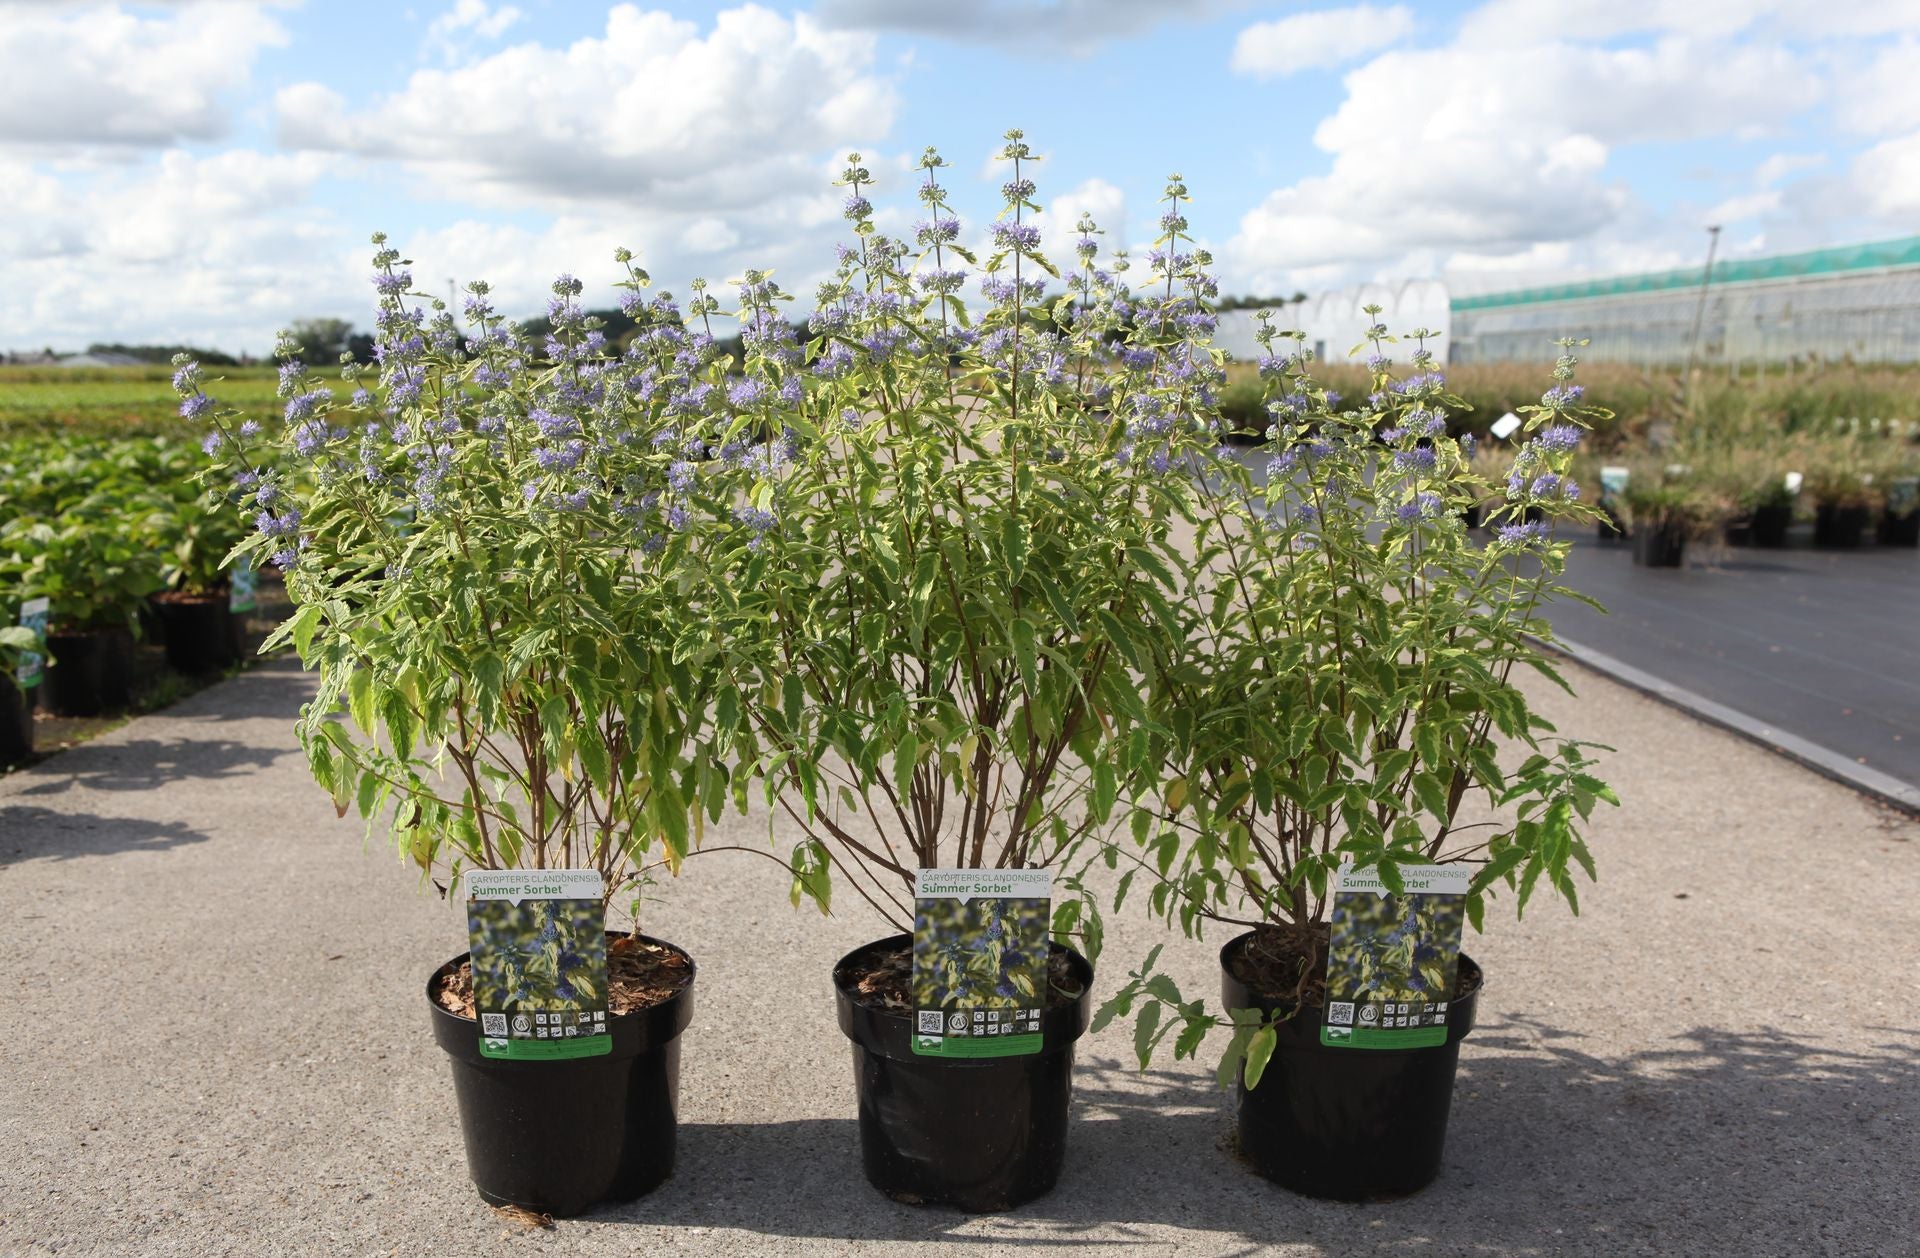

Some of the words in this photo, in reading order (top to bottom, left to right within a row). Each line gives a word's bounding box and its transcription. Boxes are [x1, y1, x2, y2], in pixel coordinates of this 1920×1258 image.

[471, 875, 529, 884] CARYOPTERIS
[531, 874, 599, 883] CLANDONENSIS
[922, 874, 980, 882] CARYOPTERIS
[982, 874, 1050, 882] CLANDONENSIS
[1343, 878, 1384, 887] Summe
[472, 885, 521, 895] Summer
[524, 885, 562, 894] Sorbet
[922, 883, 971, 893] Summer
[974, 883, 1012, 893] Sorbet
